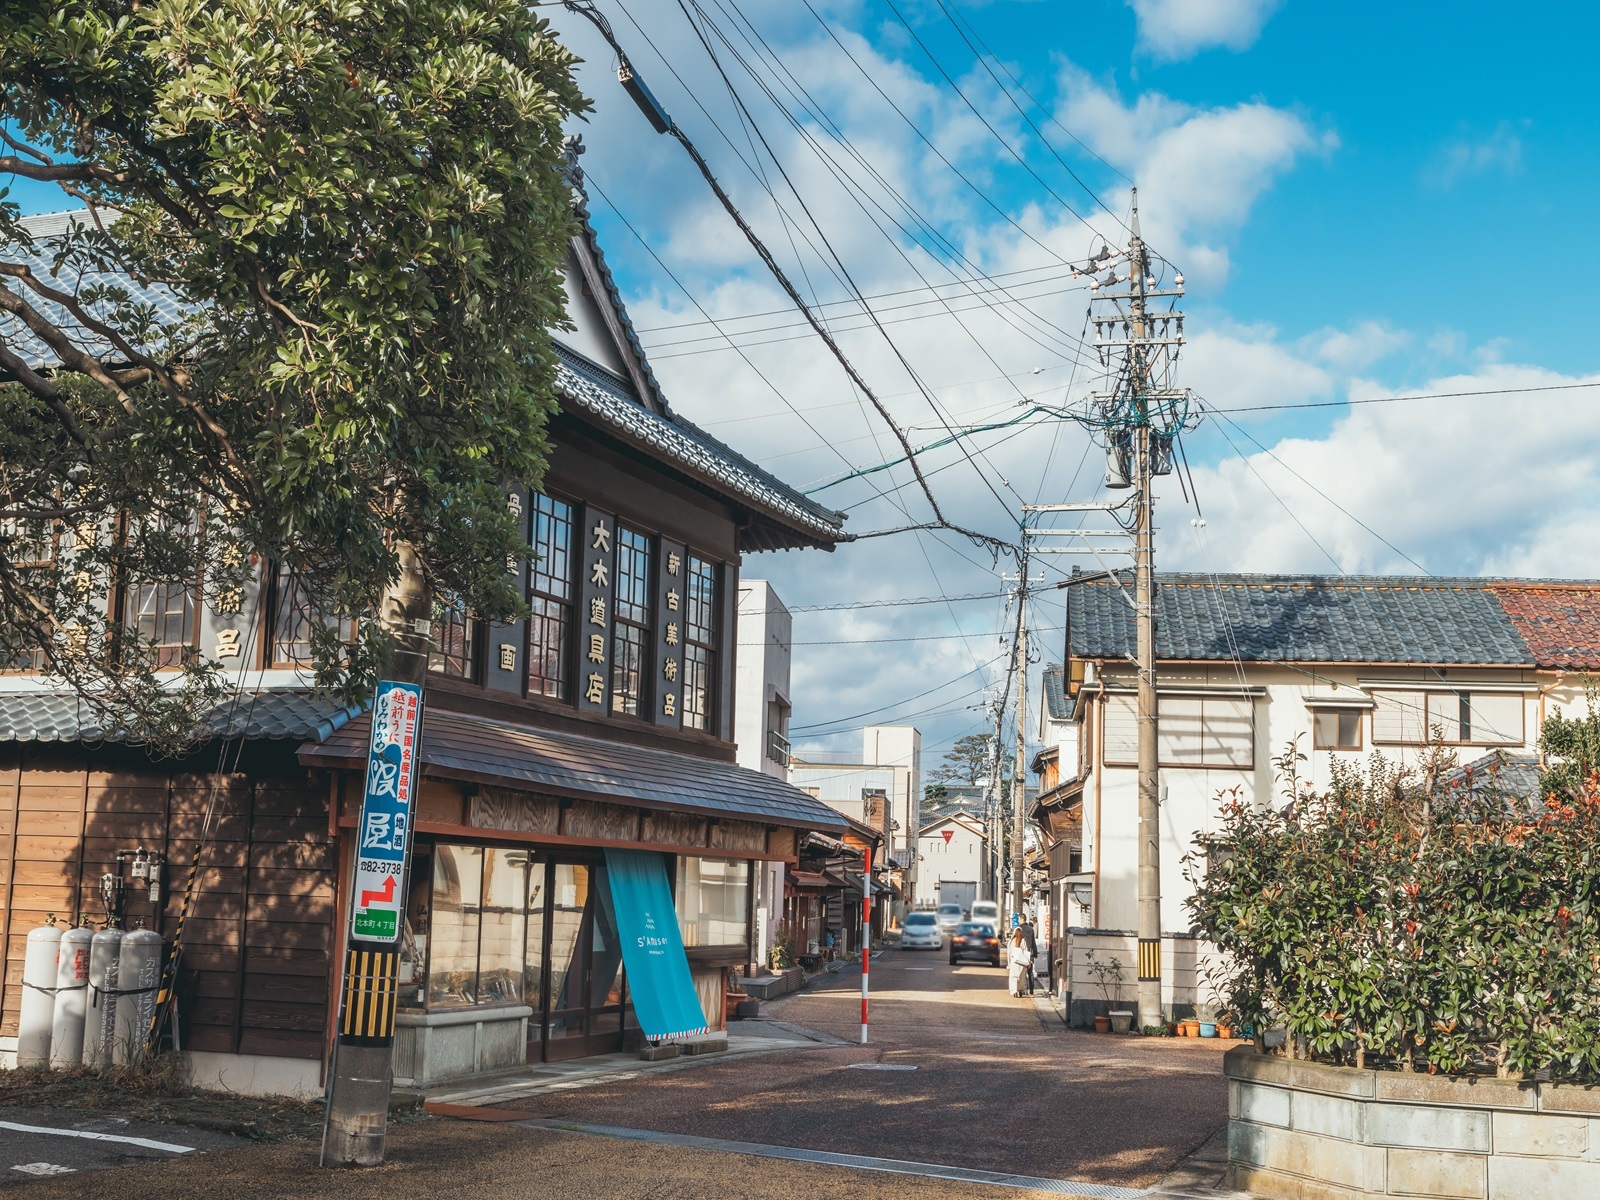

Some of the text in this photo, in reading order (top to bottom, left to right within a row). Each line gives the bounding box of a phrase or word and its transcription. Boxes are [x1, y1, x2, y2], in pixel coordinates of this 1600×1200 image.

[586, 519, 610, 705] 大木道具店
[662, 551, 681, 717] 新古美術品
[374, 697, 389, 750] もみわかめ
[388, 691, 406, 743] 越前うに
[398, 695, 418, 801] 越前三国名産品処
[393, 816, 404, 848] 地酒
[366, 861, 402, 875] 82-3738
